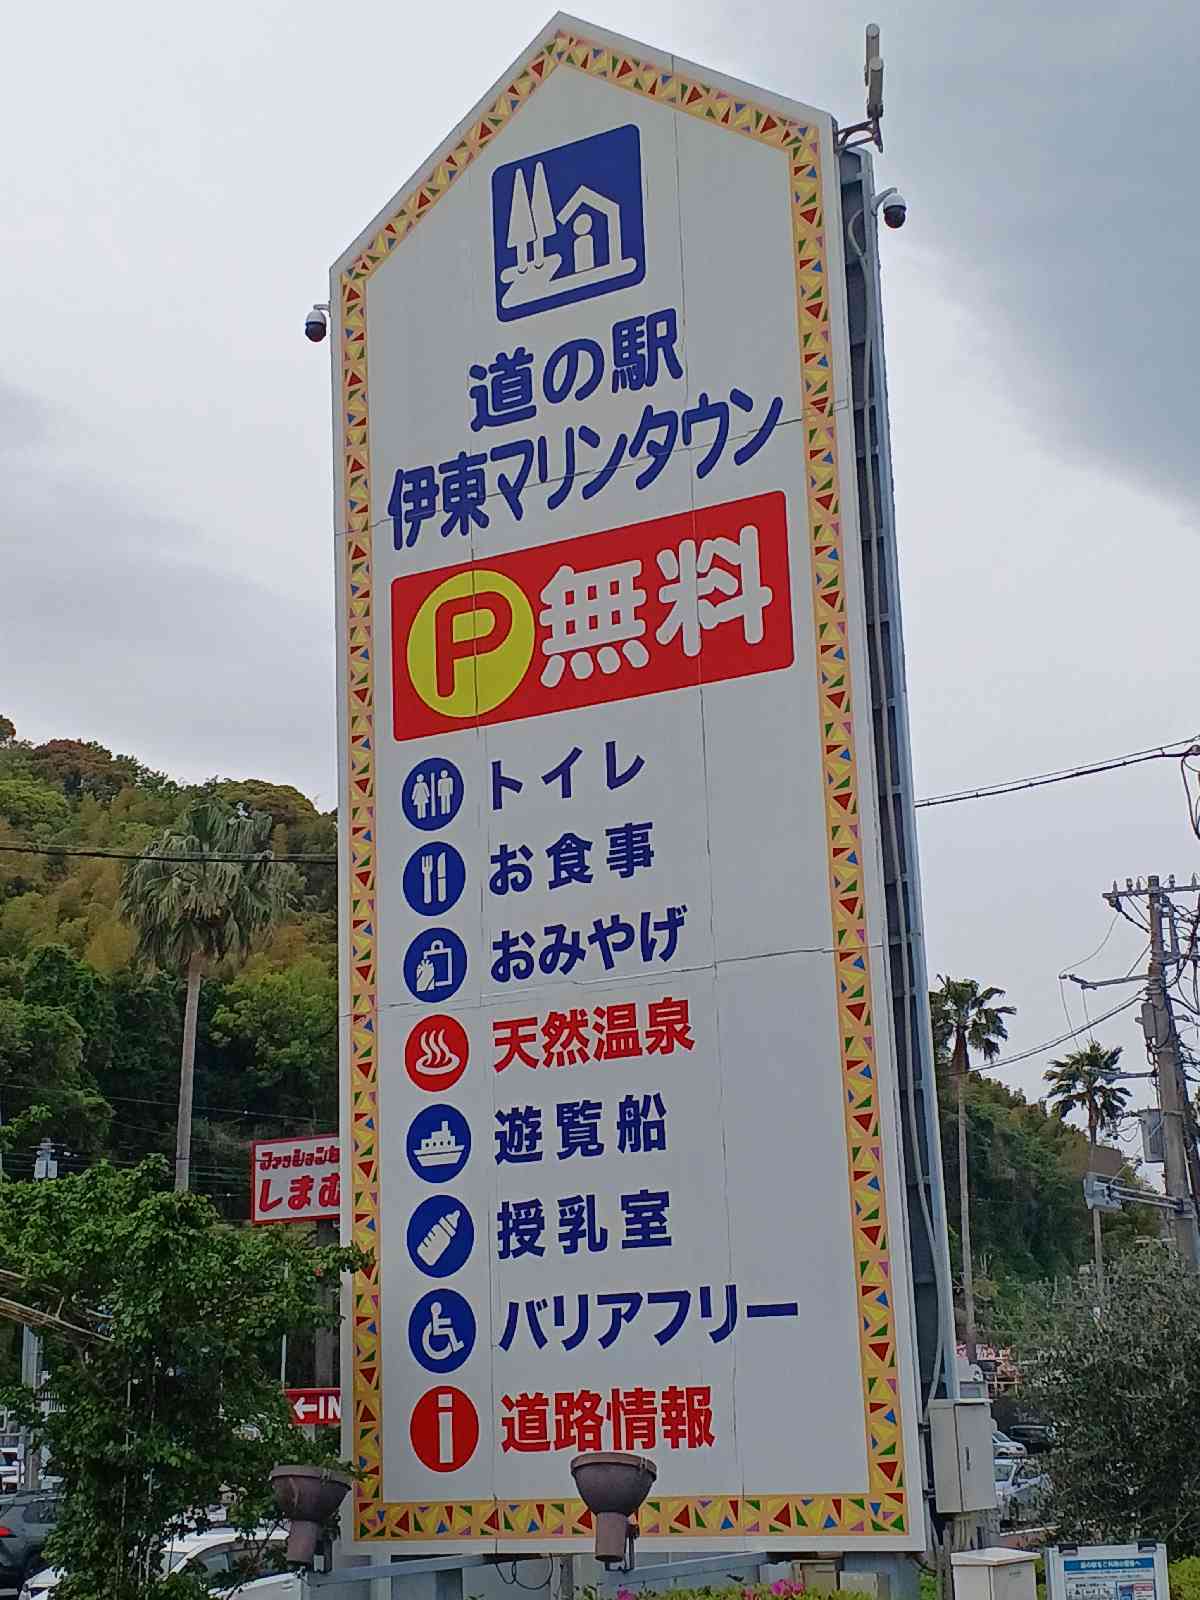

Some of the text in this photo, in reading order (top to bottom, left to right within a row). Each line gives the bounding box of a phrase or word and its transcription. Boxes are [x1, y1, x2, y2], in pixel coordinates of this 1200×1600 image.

[469, 308, 683, 432] 道の駅
[388, 388, 783, 550] 伊東マリンタウン
[434, 526, 772, 698] P 無料
[492, 740, 643, 810] トイレ
[489, 822, 653, 895] お食事
[491, 905, 687, 983] おみやげ
[493, 997, 695, 1072] 天然温泉
[495, 1093, 666, 1165] 遊覧船
[497, 1190, 672, 1259] 授乳室
[498, 1285, 797, 1351] バリアフリー
[502, 1386, 715, 1453] 道路情報
